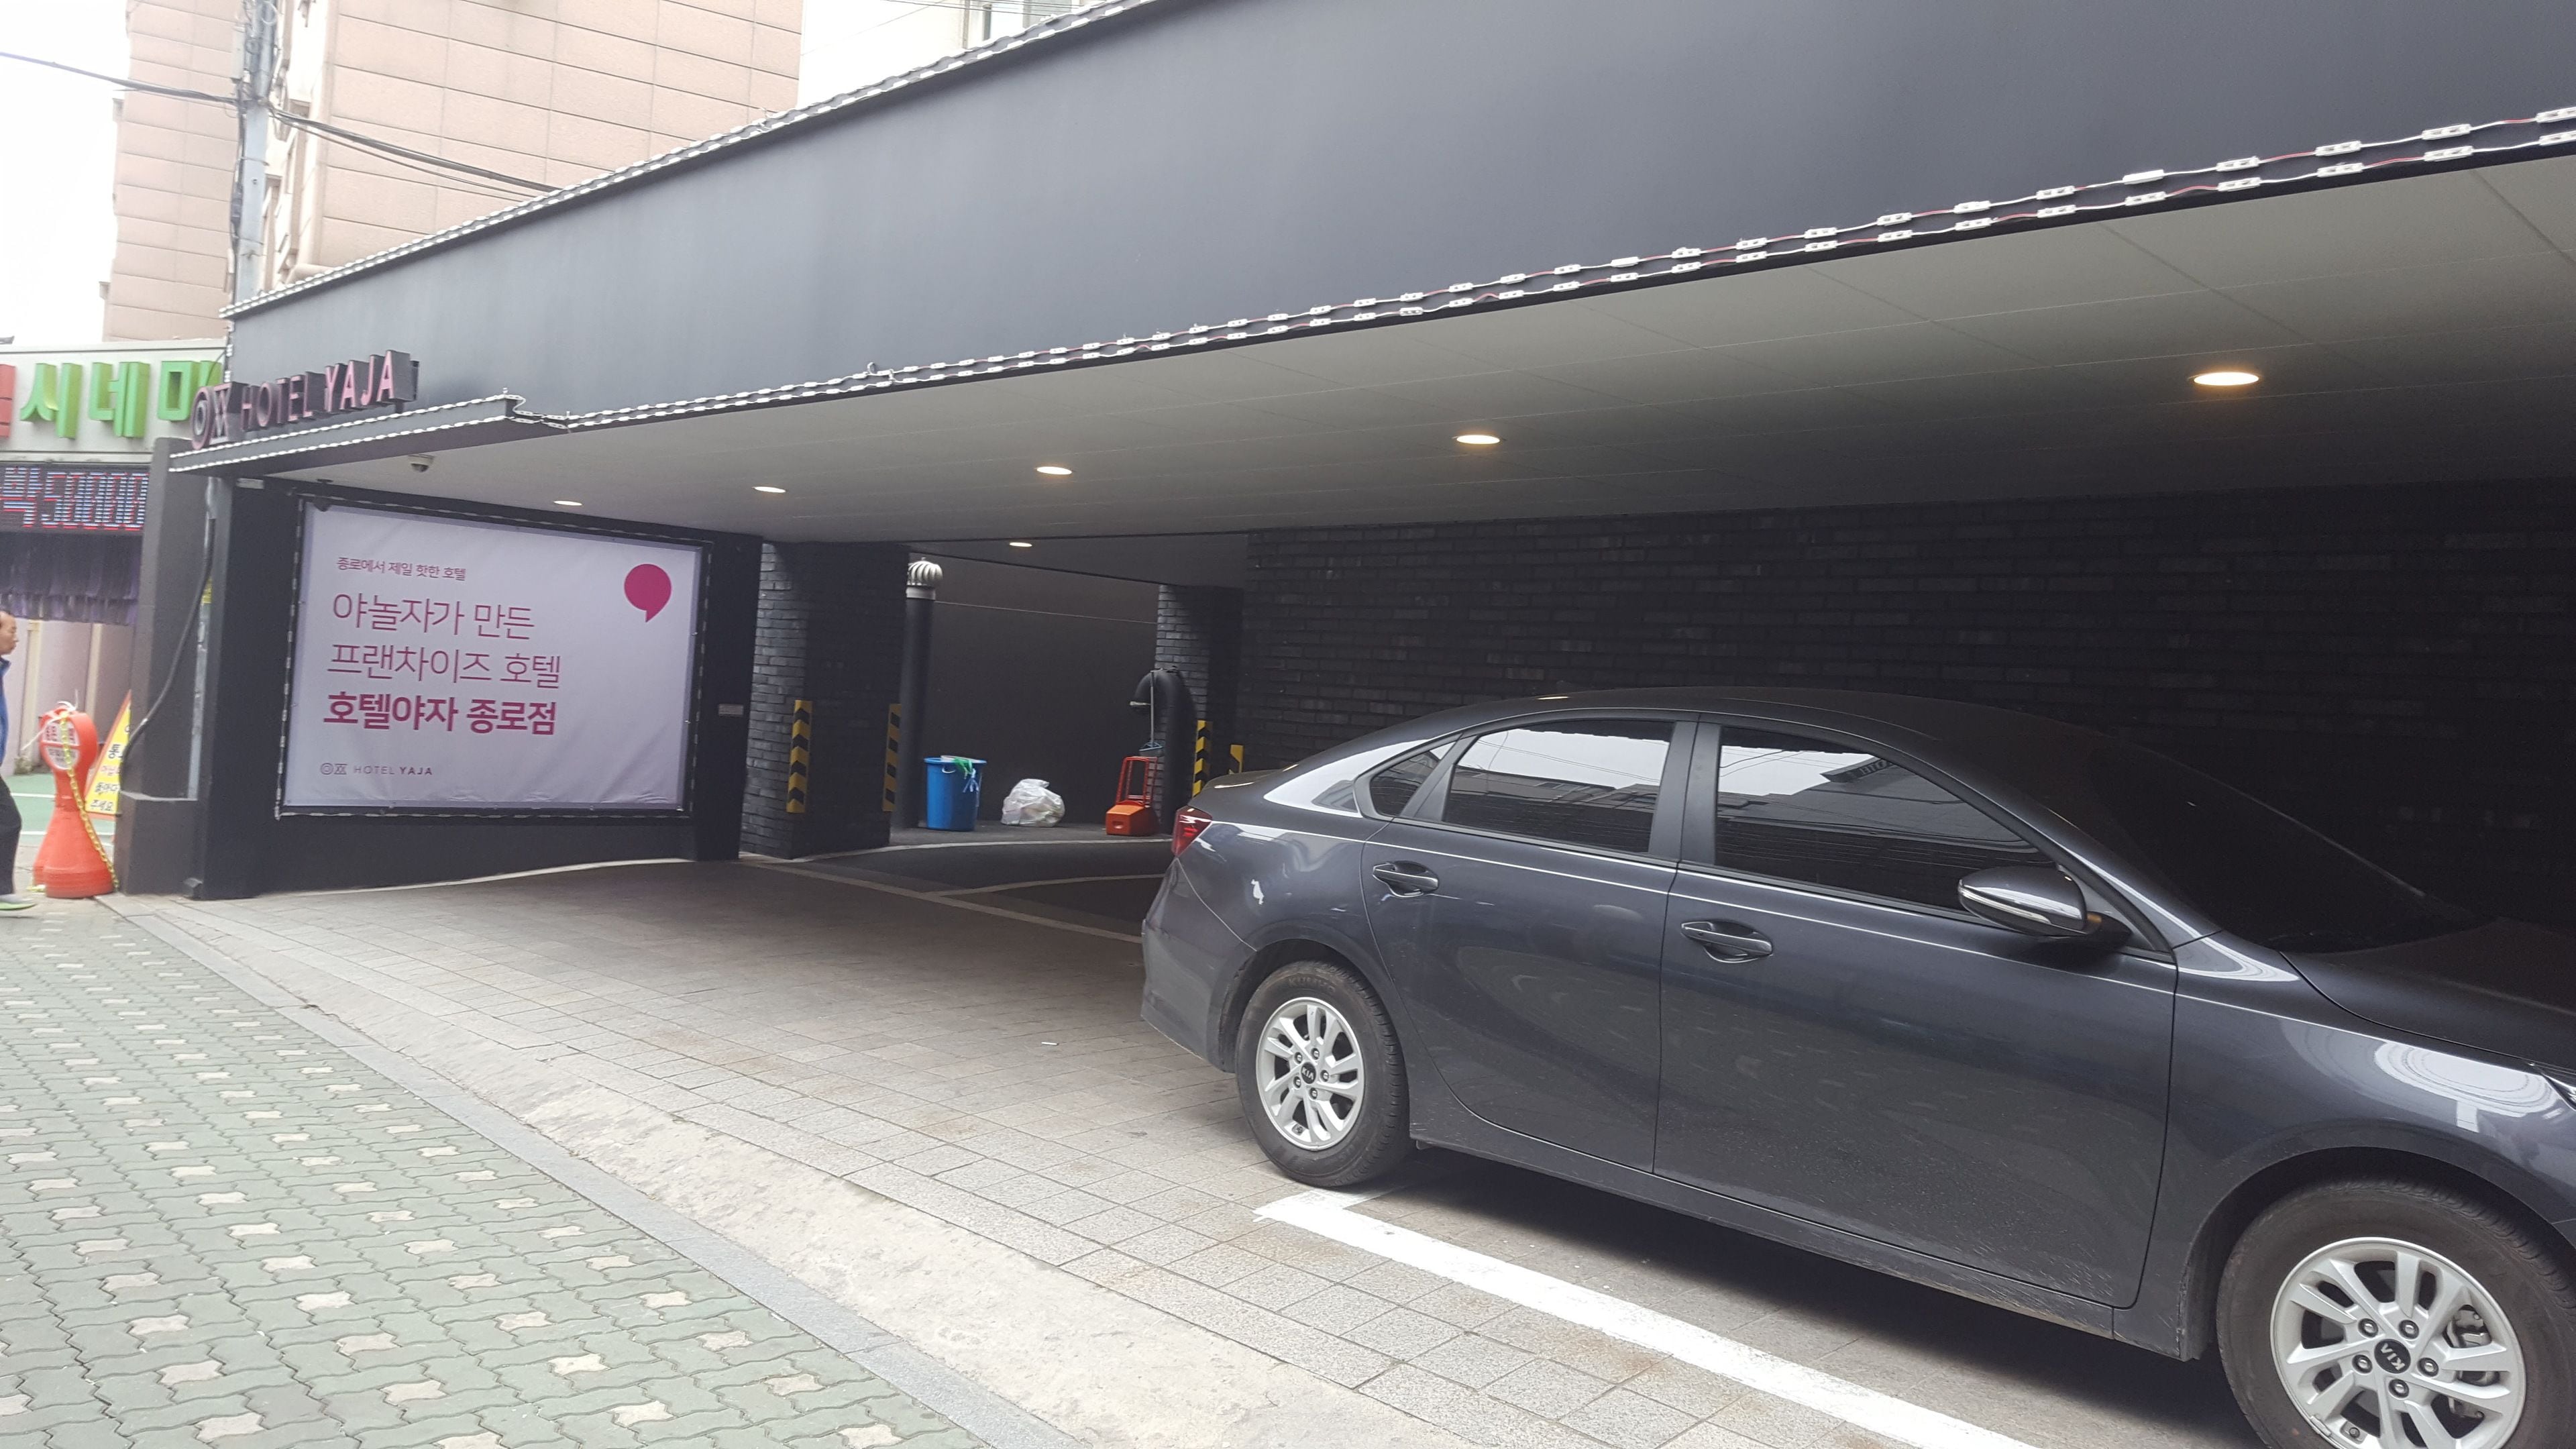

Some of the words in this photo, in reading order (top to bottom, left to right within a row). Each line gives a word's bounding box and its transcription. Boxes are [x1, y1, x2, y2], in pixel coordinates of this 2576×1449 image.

[241, 373, 317, 431] HOTEL
[325, 350, 402, 412] YAJA
[337, 557, 385, 574] 종로에서
[388, 562, 413, 576] 제일
[415, 564, 440, 579] 핫한
[442, 567, 466, 581] 호텔
[333, 593, 465, 635] 야놀자가
[474, 604, 535, 640] 만든
[327, 643, 492, 684] 프랜차이즈
[500, 653, 561, 689] 호텔
[323, 691, 459, 732] 호텔야자
[466, 698, 557, 736] 종로점
[354, 765, 395, 775] HOTEL
[399, 766, 433, 775] YAJA
[1301, 1067, 1314, 1080] KIA
[2380, 1342, 2406, 1371] KIA
